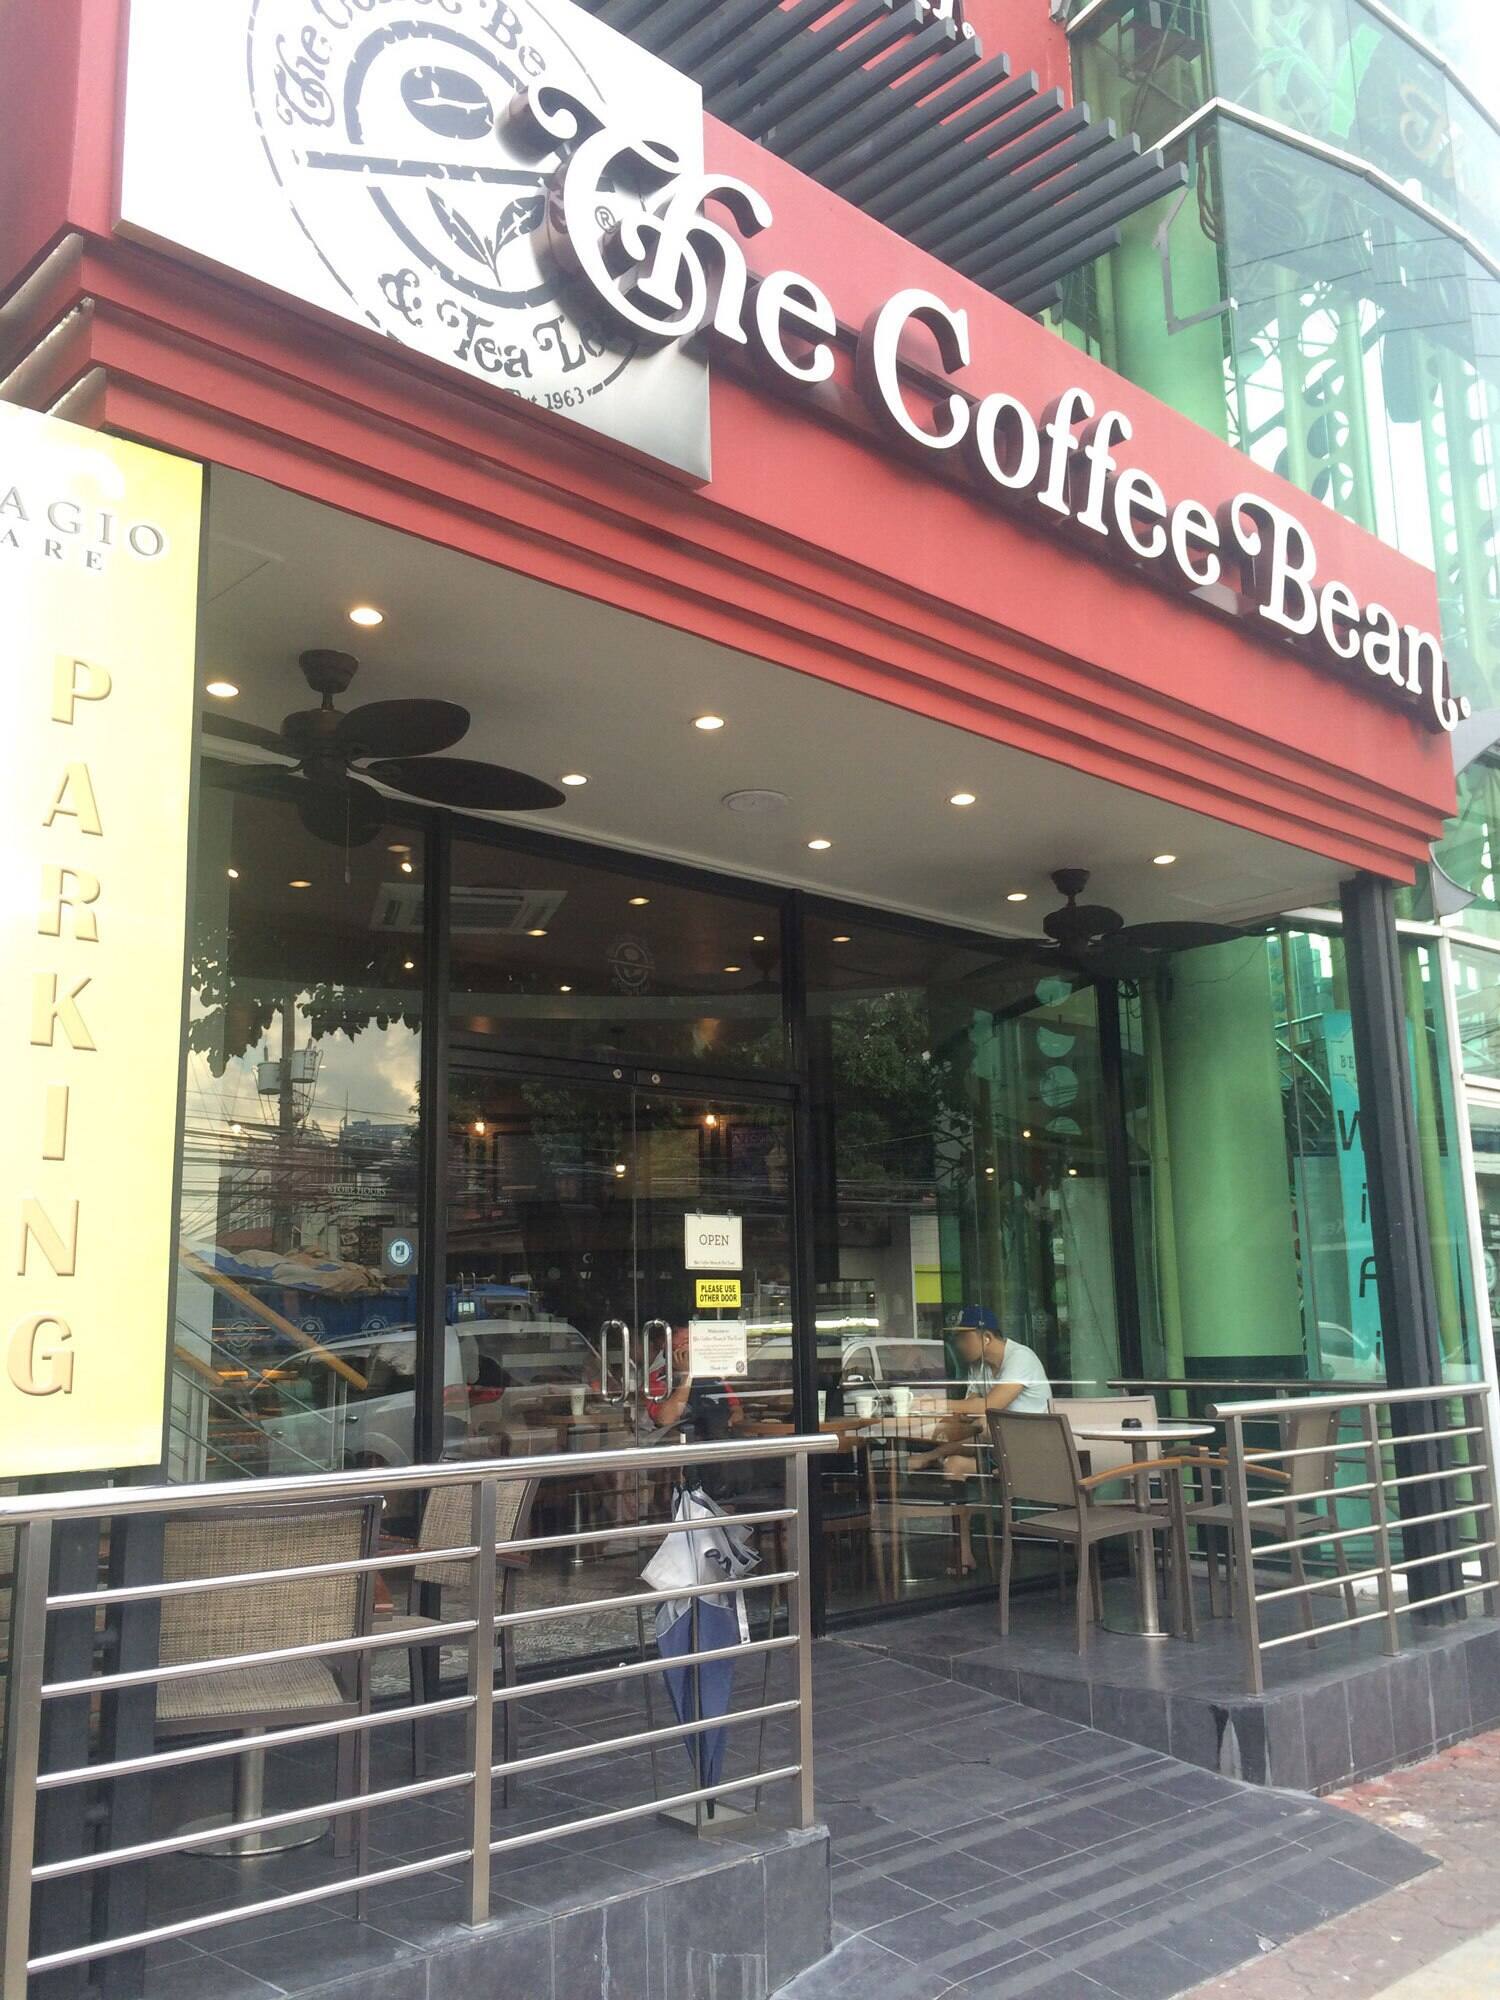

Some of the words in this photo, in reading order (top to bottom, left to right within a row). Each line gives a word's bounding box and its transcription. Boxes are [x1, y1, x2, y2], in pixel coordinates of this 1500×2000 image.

[437, 299, 532, 378] Tea
[527, 82, 837, 383] The
[873, 288, 1221, 586] Coffee
[544, 386, 585, 410] 1963
[0, 486, 164, 557] AGIO
[6, 652, 112, 1397] PARKING
[699, 1234, 729, 1246] OPEN
[700, 1294, 719, 1302] OTHER
[721, 1294, 737, 1302] DOOR
[701, 1284, 723, 1293] PLEASE
[724, 1284, 736, 1293] USE
